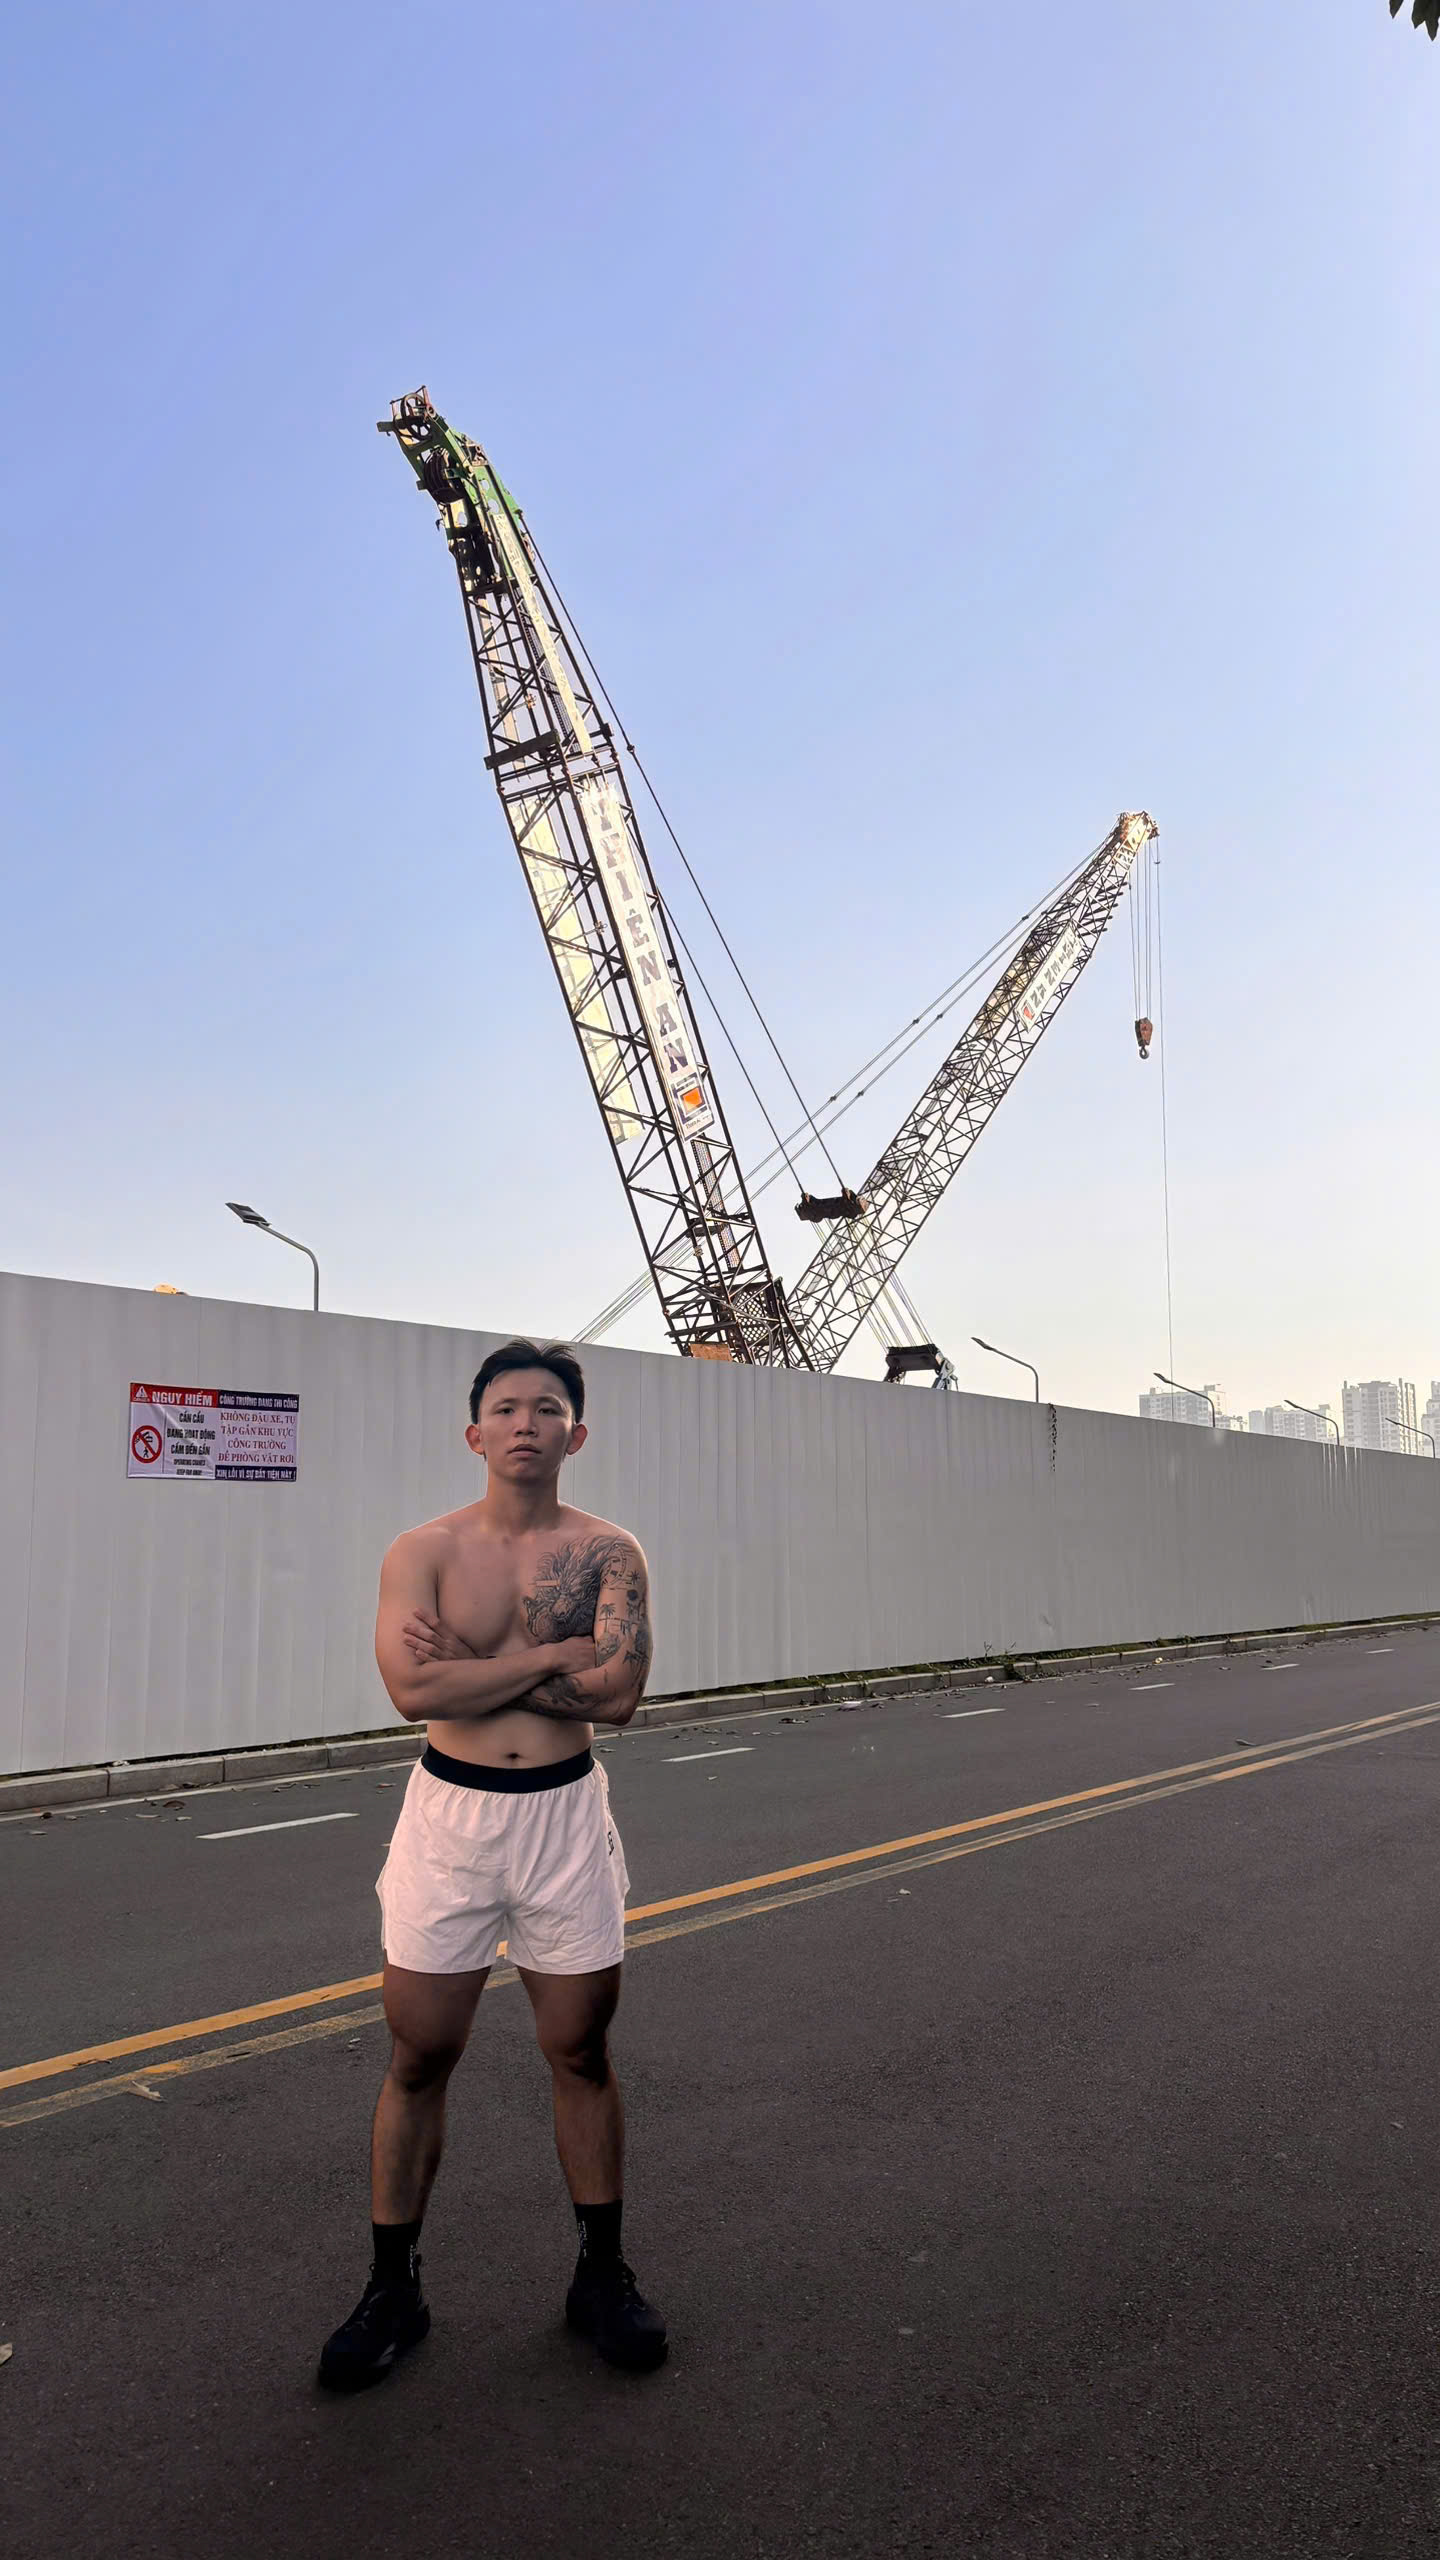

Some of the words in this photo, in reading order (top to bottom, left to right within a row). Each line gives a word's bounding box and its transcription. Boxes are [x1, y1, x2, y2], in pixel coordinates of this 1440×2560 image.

[656, 1003, 689, 1075] AN
[152, 1391, 182, 1404] NGUY
[185, 1390, 212, 1406] HIỂM
[219, 1394, 235, 1405] CÔNG
[274, 1399, 282, 1408] THI
[283, 1398, 297, 1408] CÔNG
[220, 1411, 250, 1421] KHÔNG
[252, 1412, 269, 1424] ĐẬU
[270, 1415, 283, 1424] XE,
[285, 1415, 296, 1424] TỤ
[220, 1424, 237, 1436] TẬP
[258, 1427, 275, 1436] KHU
[278, 1428, 293, 1438] VỰC
[227, 1438, 251, 1448] CÔNG
[253, 1440, 286, 1449] TRƯỜNG
[231, 1452, 259, 1462] PHÒNG
[262, 1453, 278, 1464] VẬT
[280, 1455, 294, 1463] RƠI
